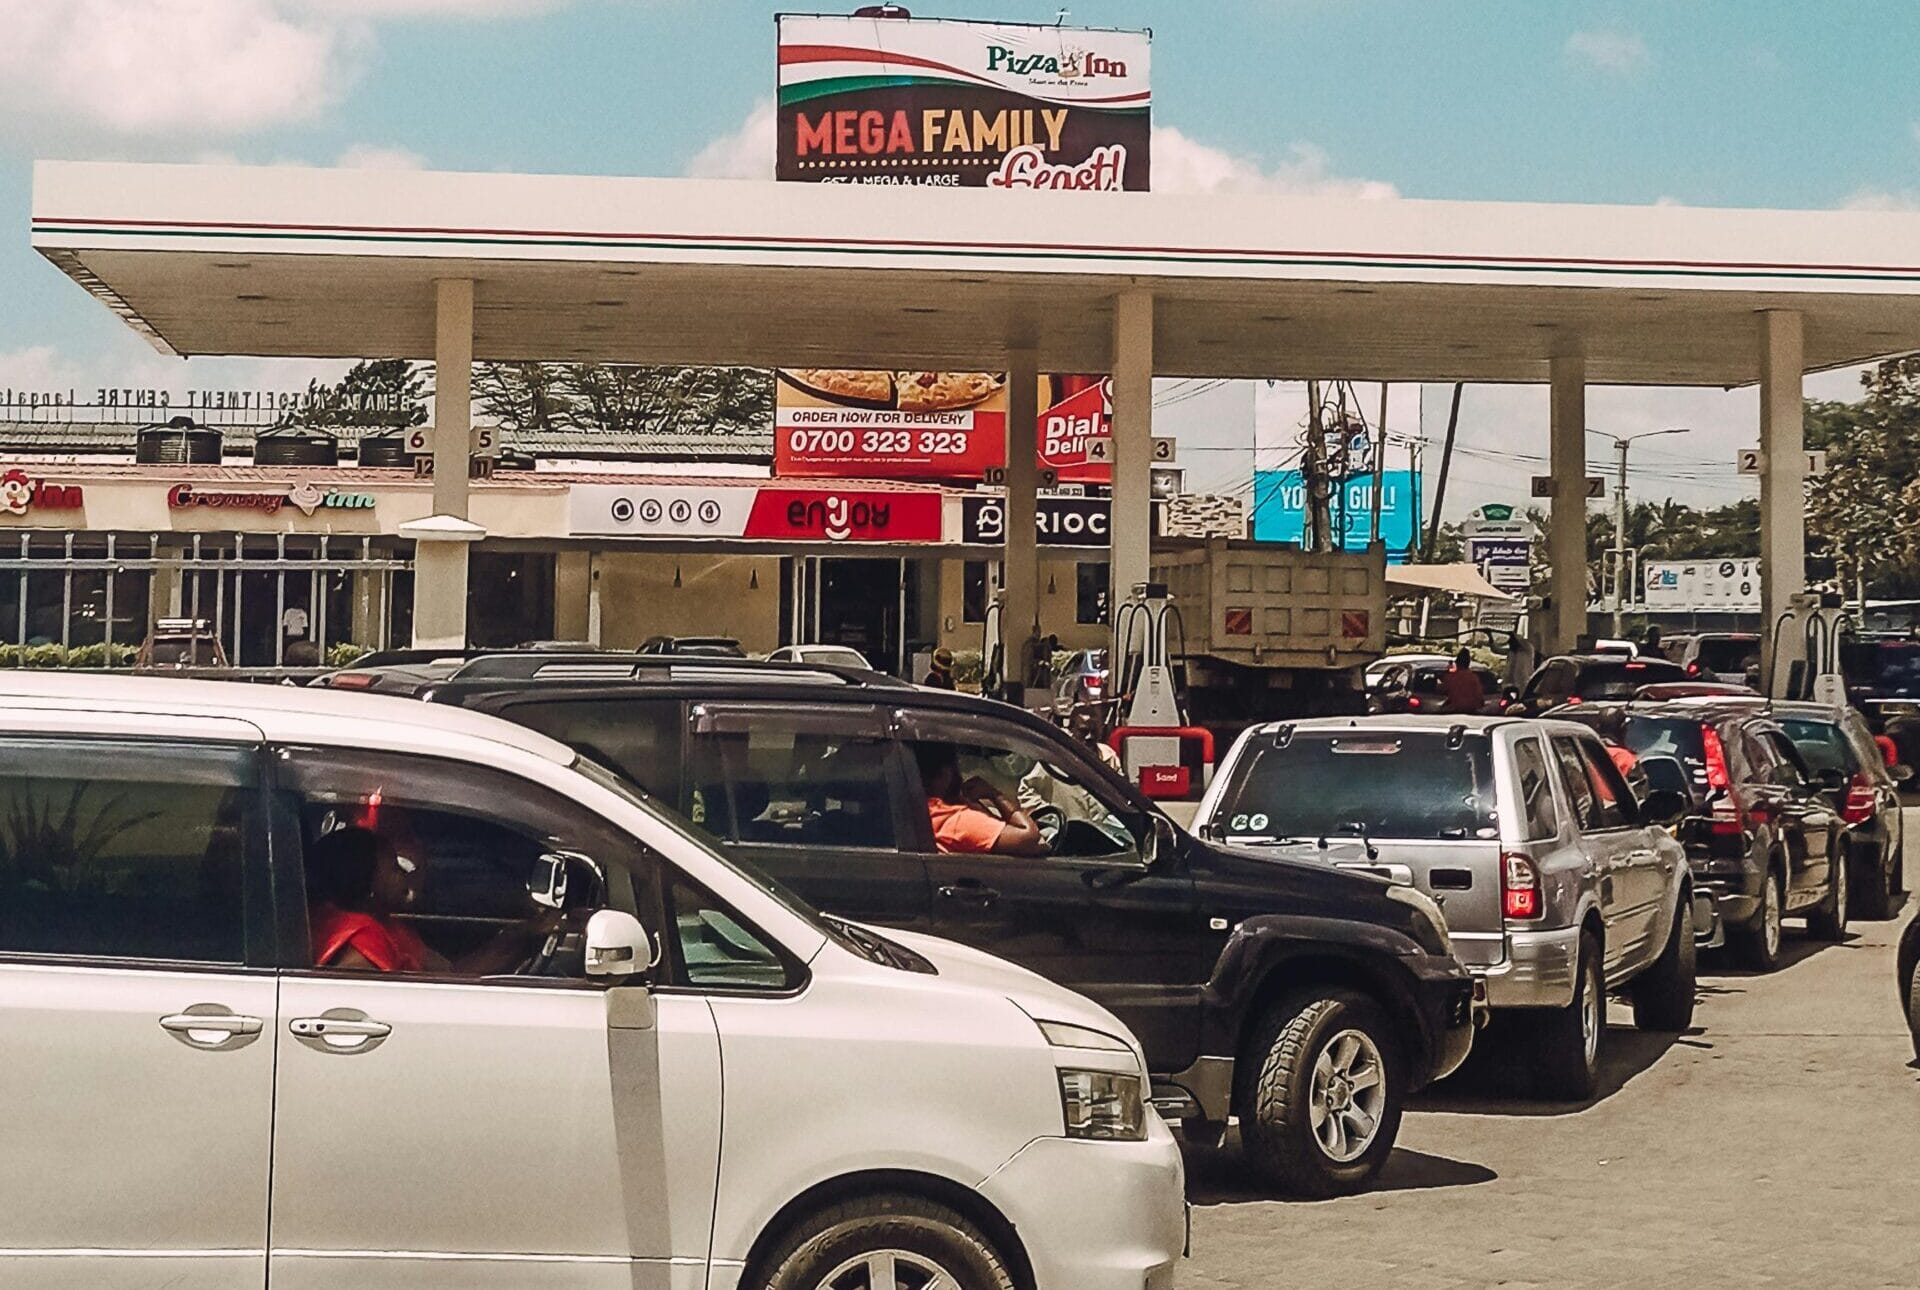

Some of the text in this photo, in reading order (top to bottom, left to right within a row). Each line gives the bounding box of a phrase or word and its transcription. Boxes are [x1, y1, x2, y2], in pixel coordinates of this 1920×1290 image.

[986, 46, 1127, 77] Pizza Inn
[797, 108, 1068, 156] MEGA FAMILY
[863, 175, 900, 186] MEGA
[917, 174, 960, 187] LARGE
[792, 411, 966, 425] ORDER NOW FOR DELIVERY
[1046, 412, 1100, 439] Dial
[410, 431, 425, 449] 6
[479, 431, 493, 449] 5
[790, 430, 967, 454] 0700 323 323
[1091, 441, 1106, 458] 4
[1156, 441, 1170, 459] 3
[416, 459, 434, 475] 12
[1744, 453, 1760, 470] 2
[1809, 456, 1815, 472] 1
[985, 469, 1004, 483] 10
[1043, 470, 1055, 486] 9
[1588, 480, 1600, 495] 7
[1349, 485, 1396, 510] GIL!
[787, 496, 890, 530] enjoy
[1036, 511, 1106, 534] RIOC
[1155, 772, 1178, 782] Sand
